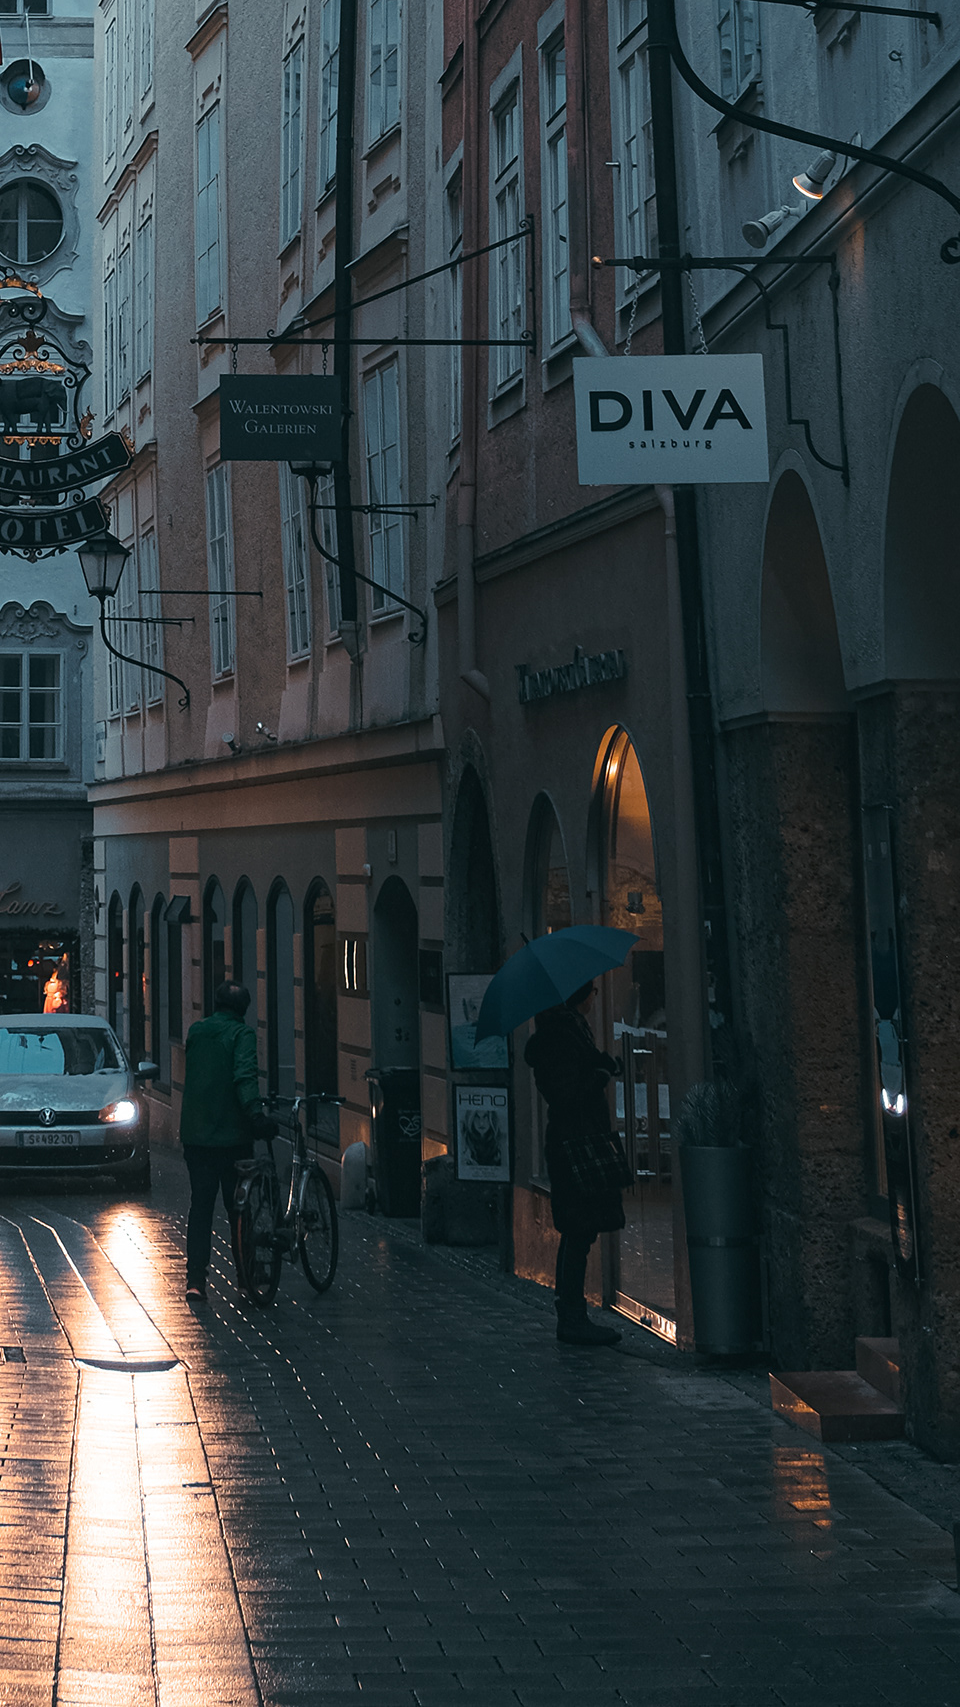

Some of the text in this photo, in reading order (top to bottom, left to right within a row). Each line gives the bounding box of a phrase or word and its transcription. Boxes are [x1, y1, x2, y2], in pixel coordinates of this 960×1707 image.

[589, 389, 753, 432] DIVA
[629, 439, 712, 449] salzburg
[41, 1134, 59, 1145] 492
